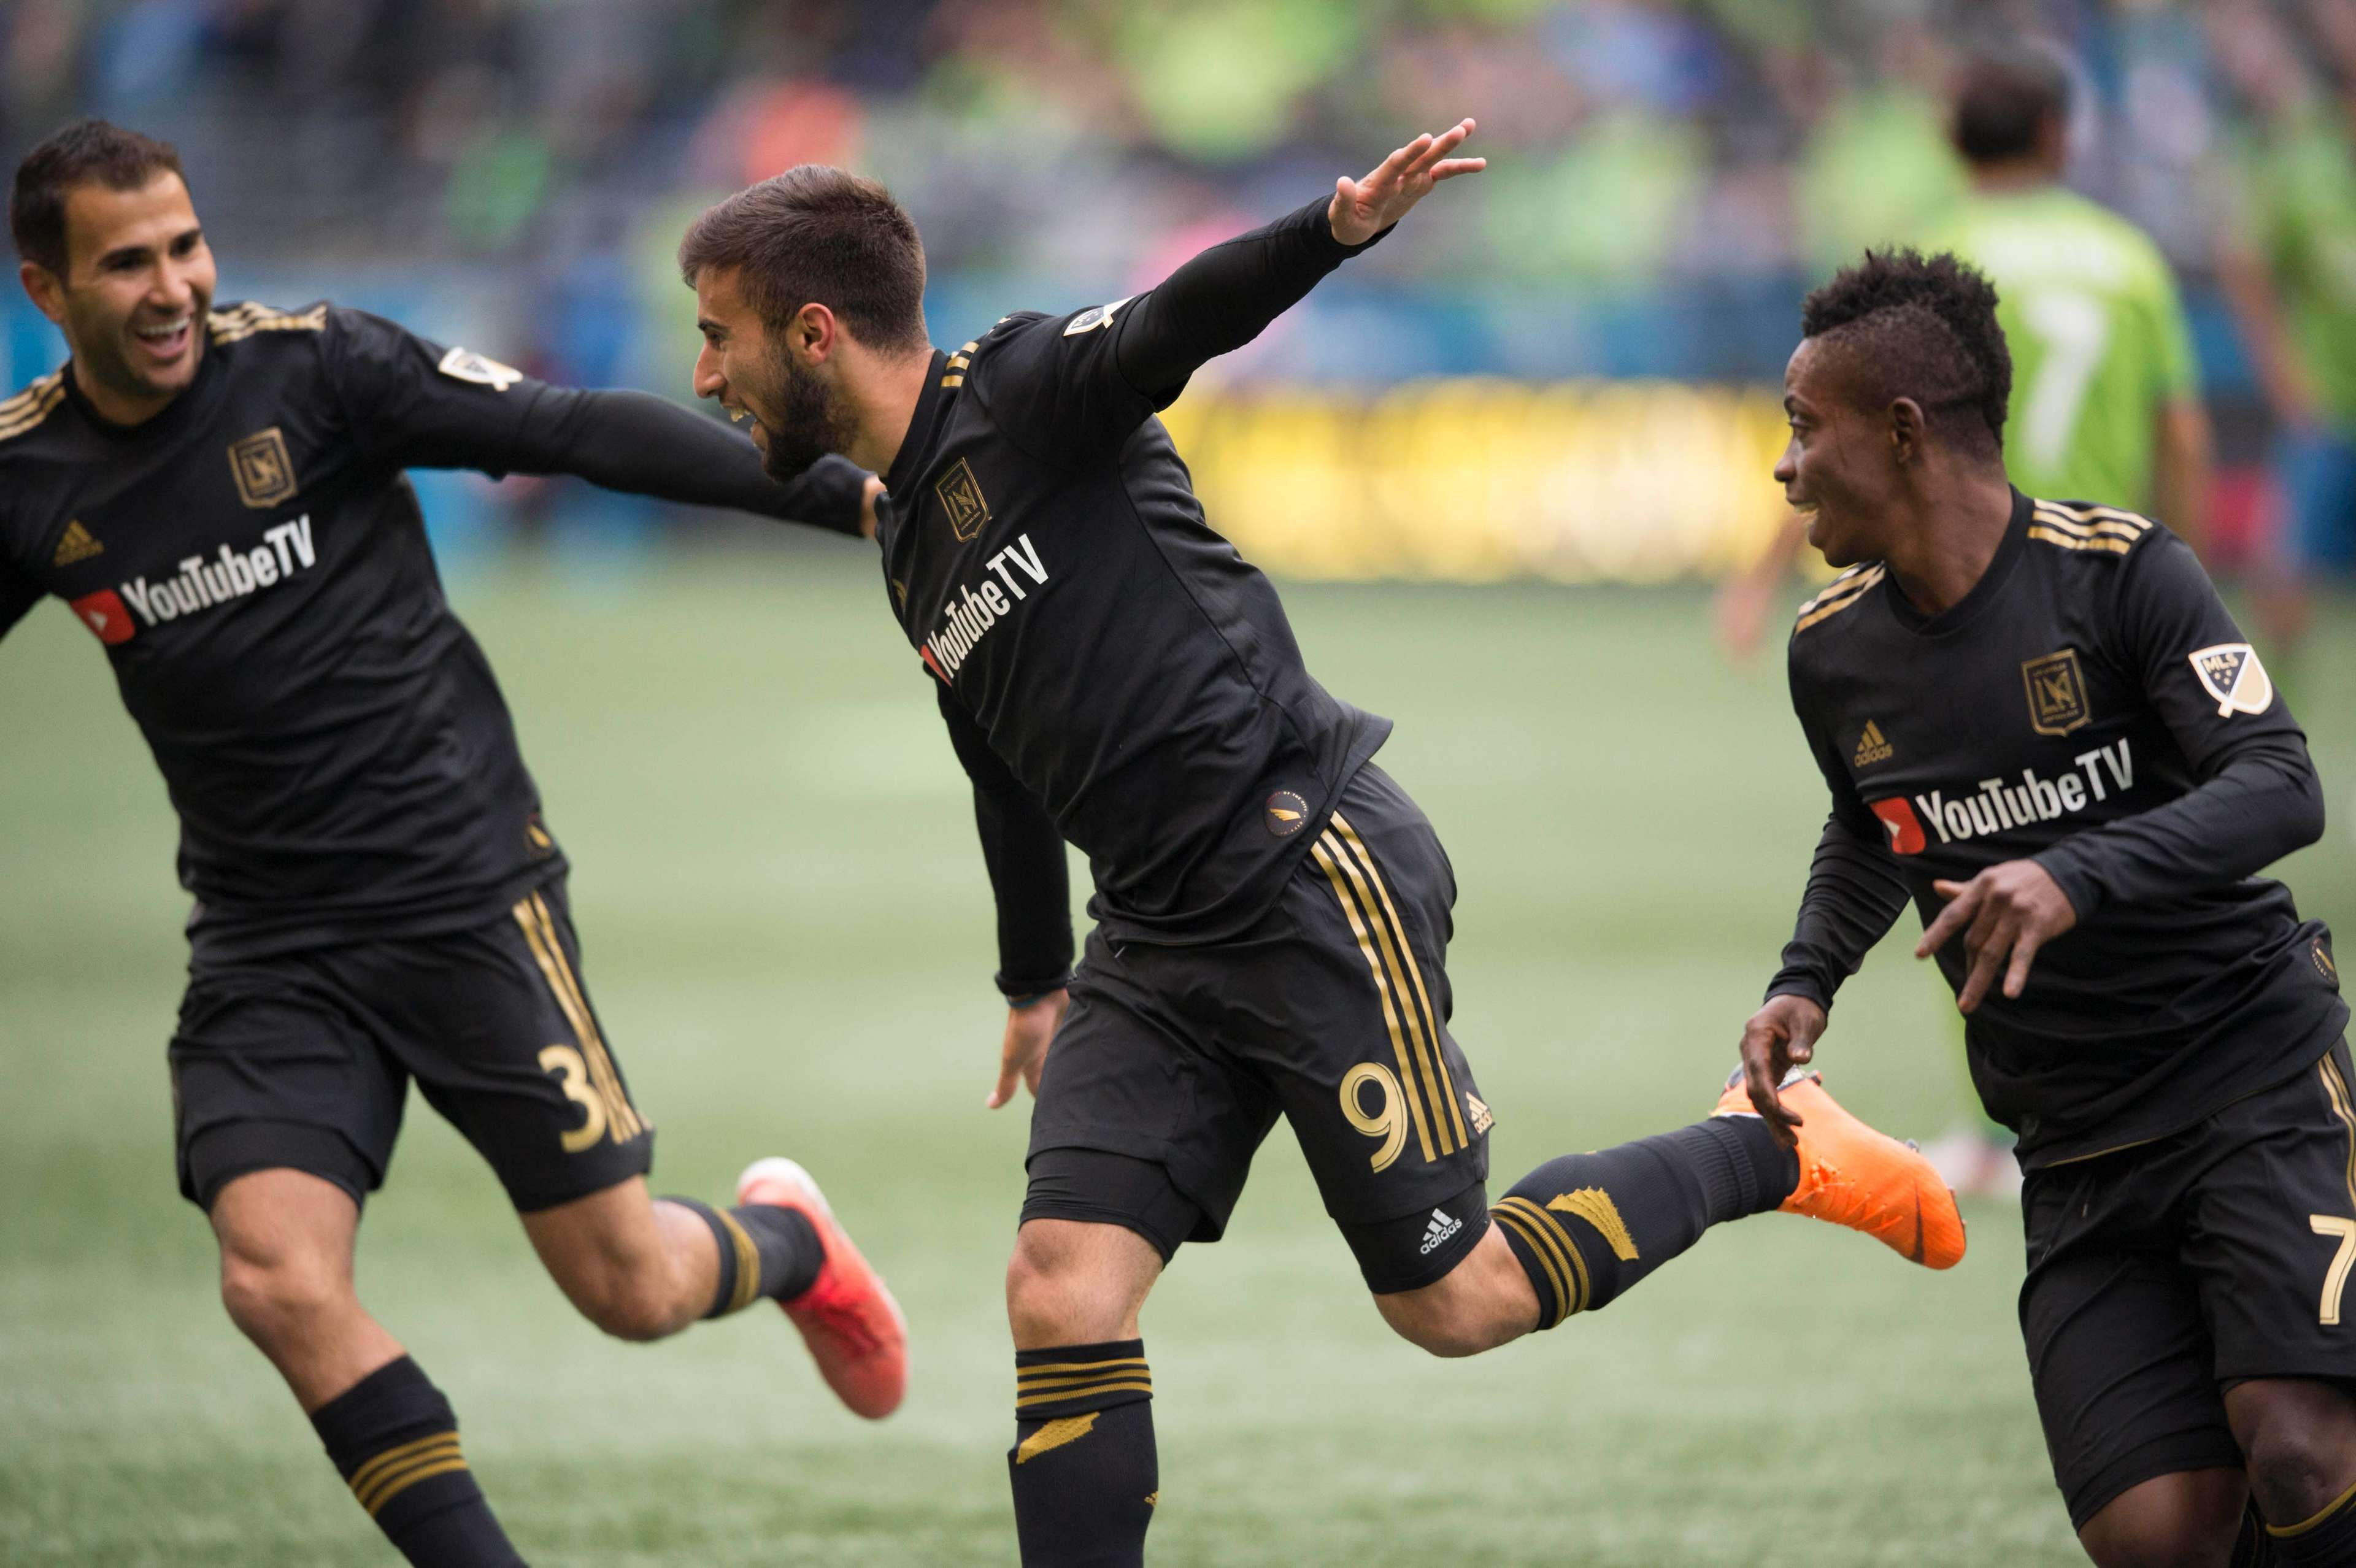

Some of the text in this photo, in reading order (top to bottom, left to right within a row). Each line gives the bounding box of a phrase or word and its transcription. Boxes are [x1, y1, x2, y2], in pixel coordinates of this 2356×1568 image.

[2023, 294, 2107, 478] 7
[120, 543, 279, 626] YouTube
[927, 533, 1049, 678] YouTube TV
[2201, 653, 2239, 674] MLS
[1855, 744, 1893, 767] adidas
[1915, 737, 2133, 843] YouTube TV
[537, 1045, 607, 1153] 3
[1339, 1062, 1408, 1174] 9
[1420, 1218, 1463, 1255] adidas
[2309, 1213, 2356, 1324] 7
